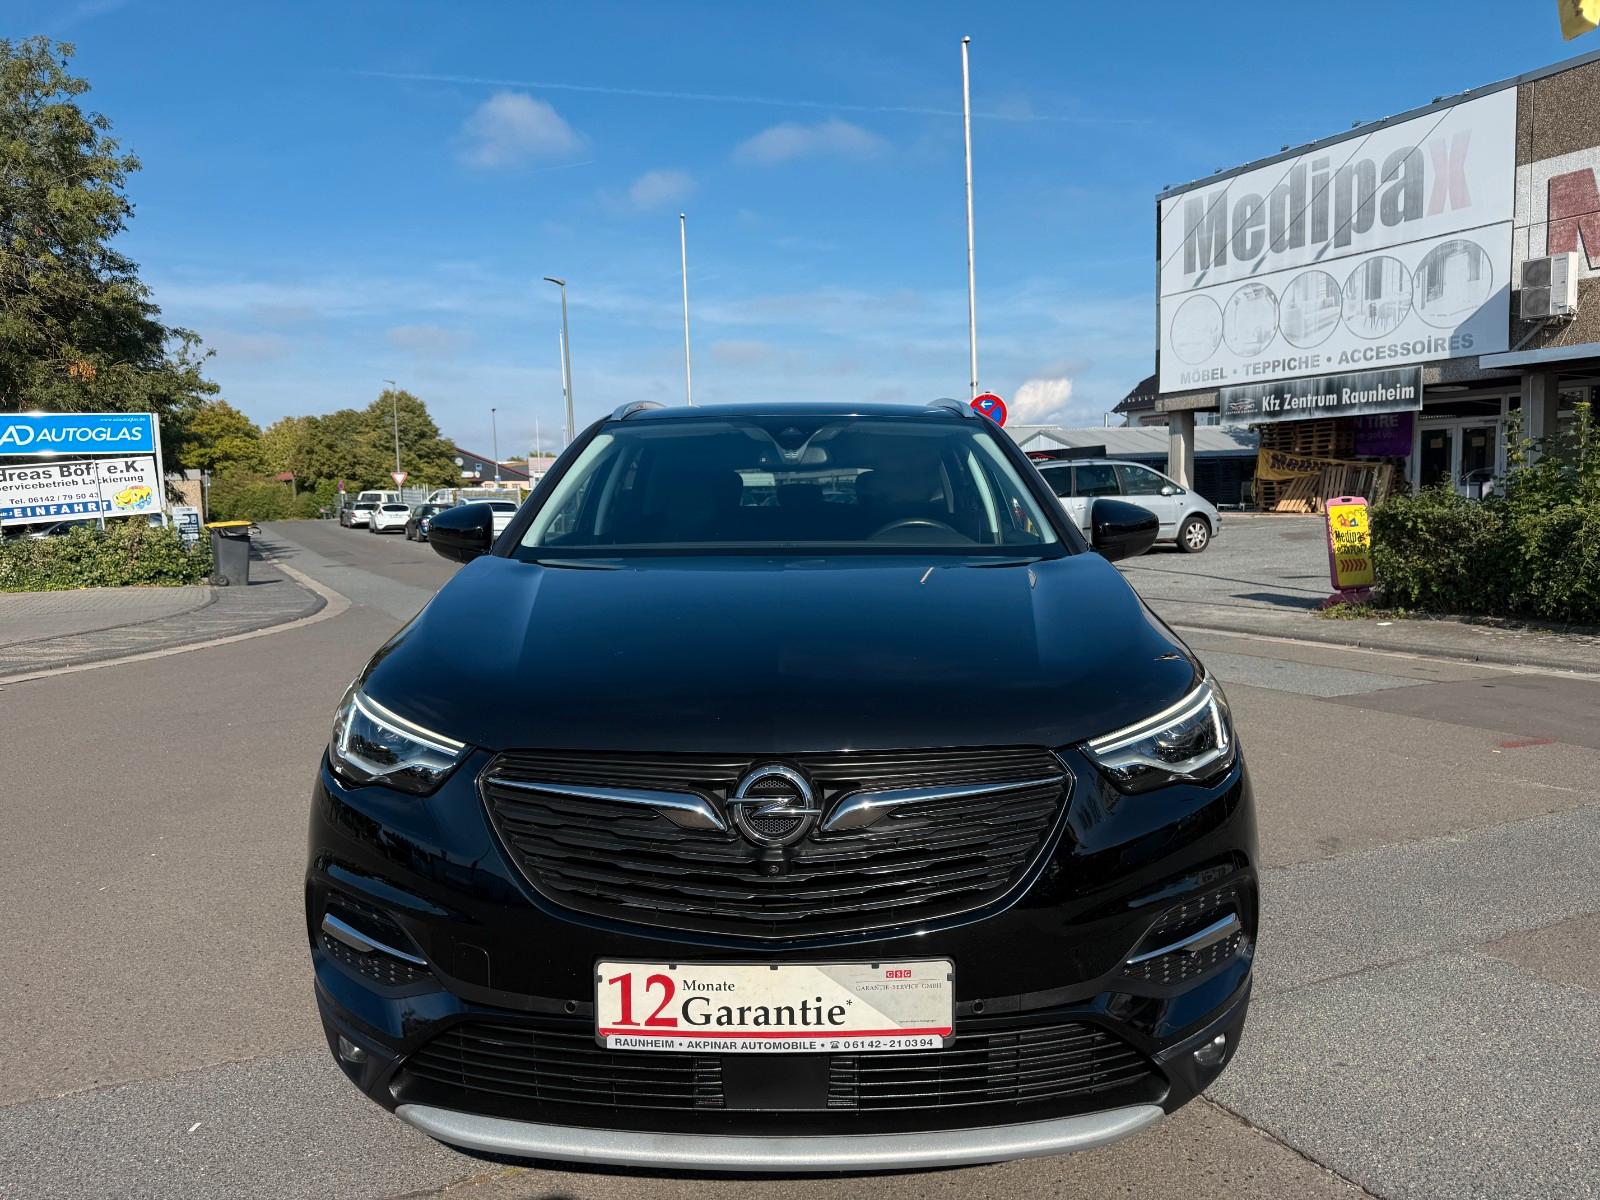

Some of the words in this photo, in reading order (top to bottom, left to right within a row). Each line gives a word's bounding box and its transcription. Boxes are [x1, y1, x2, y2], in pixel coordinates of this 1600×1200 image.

[1184, 128, 1472, 275] Medipax
[1180, 367, 1227, 384] MÖBEL
[1242, 354, 1321, 376] TEPPICHE
[1262, 394, 1280, 412] Kfz
[1283, 392, 1338, 410] Zentrum
[1342, 383, 1415, 405] Raunheim
[0, 425, 35, 446] AD
[36, 426, 143, 442] AUTOGLAS
[107, 460, 145, 474] e.K.
[0, 479, 79, 492] ervicebetrieb
[28, 495, 56, 503] 06142
[13, 500, 110, 518] EINFAHRT
[886, 970, 912, 978] GSG
[682, 980, 736, 993] Monate
[608, 972, 679, 1028] 12
[614, 1038, 675, 1049] RAUNHEIM
[687, 1041, 737, 1050] AKPINAR
[740, 1041, 817, 1050] AUTOMOBILE
